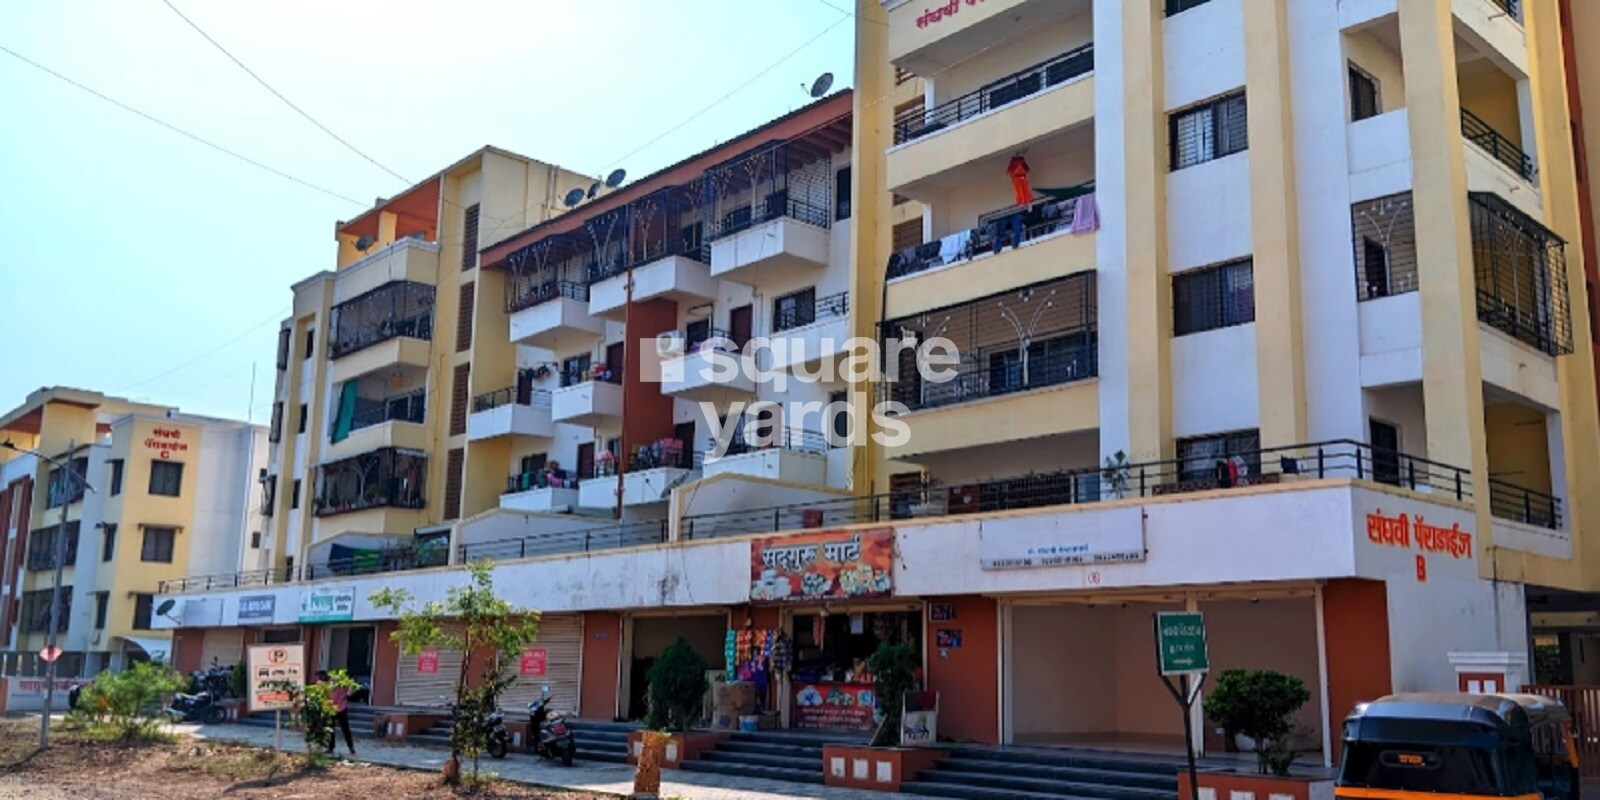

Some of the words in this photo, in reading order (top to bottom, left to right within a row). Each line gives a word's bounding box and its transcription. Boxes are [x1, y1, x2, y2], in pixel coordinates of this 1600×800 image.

[160, 451, 169, 459] C
[824, 533, 860, 562] मार्ट
[1366, 508, 1410, 548] संघवी
[1413, 514, 1472, 559] पॅराडाईज
[1416, 554, 1426, 581] B
